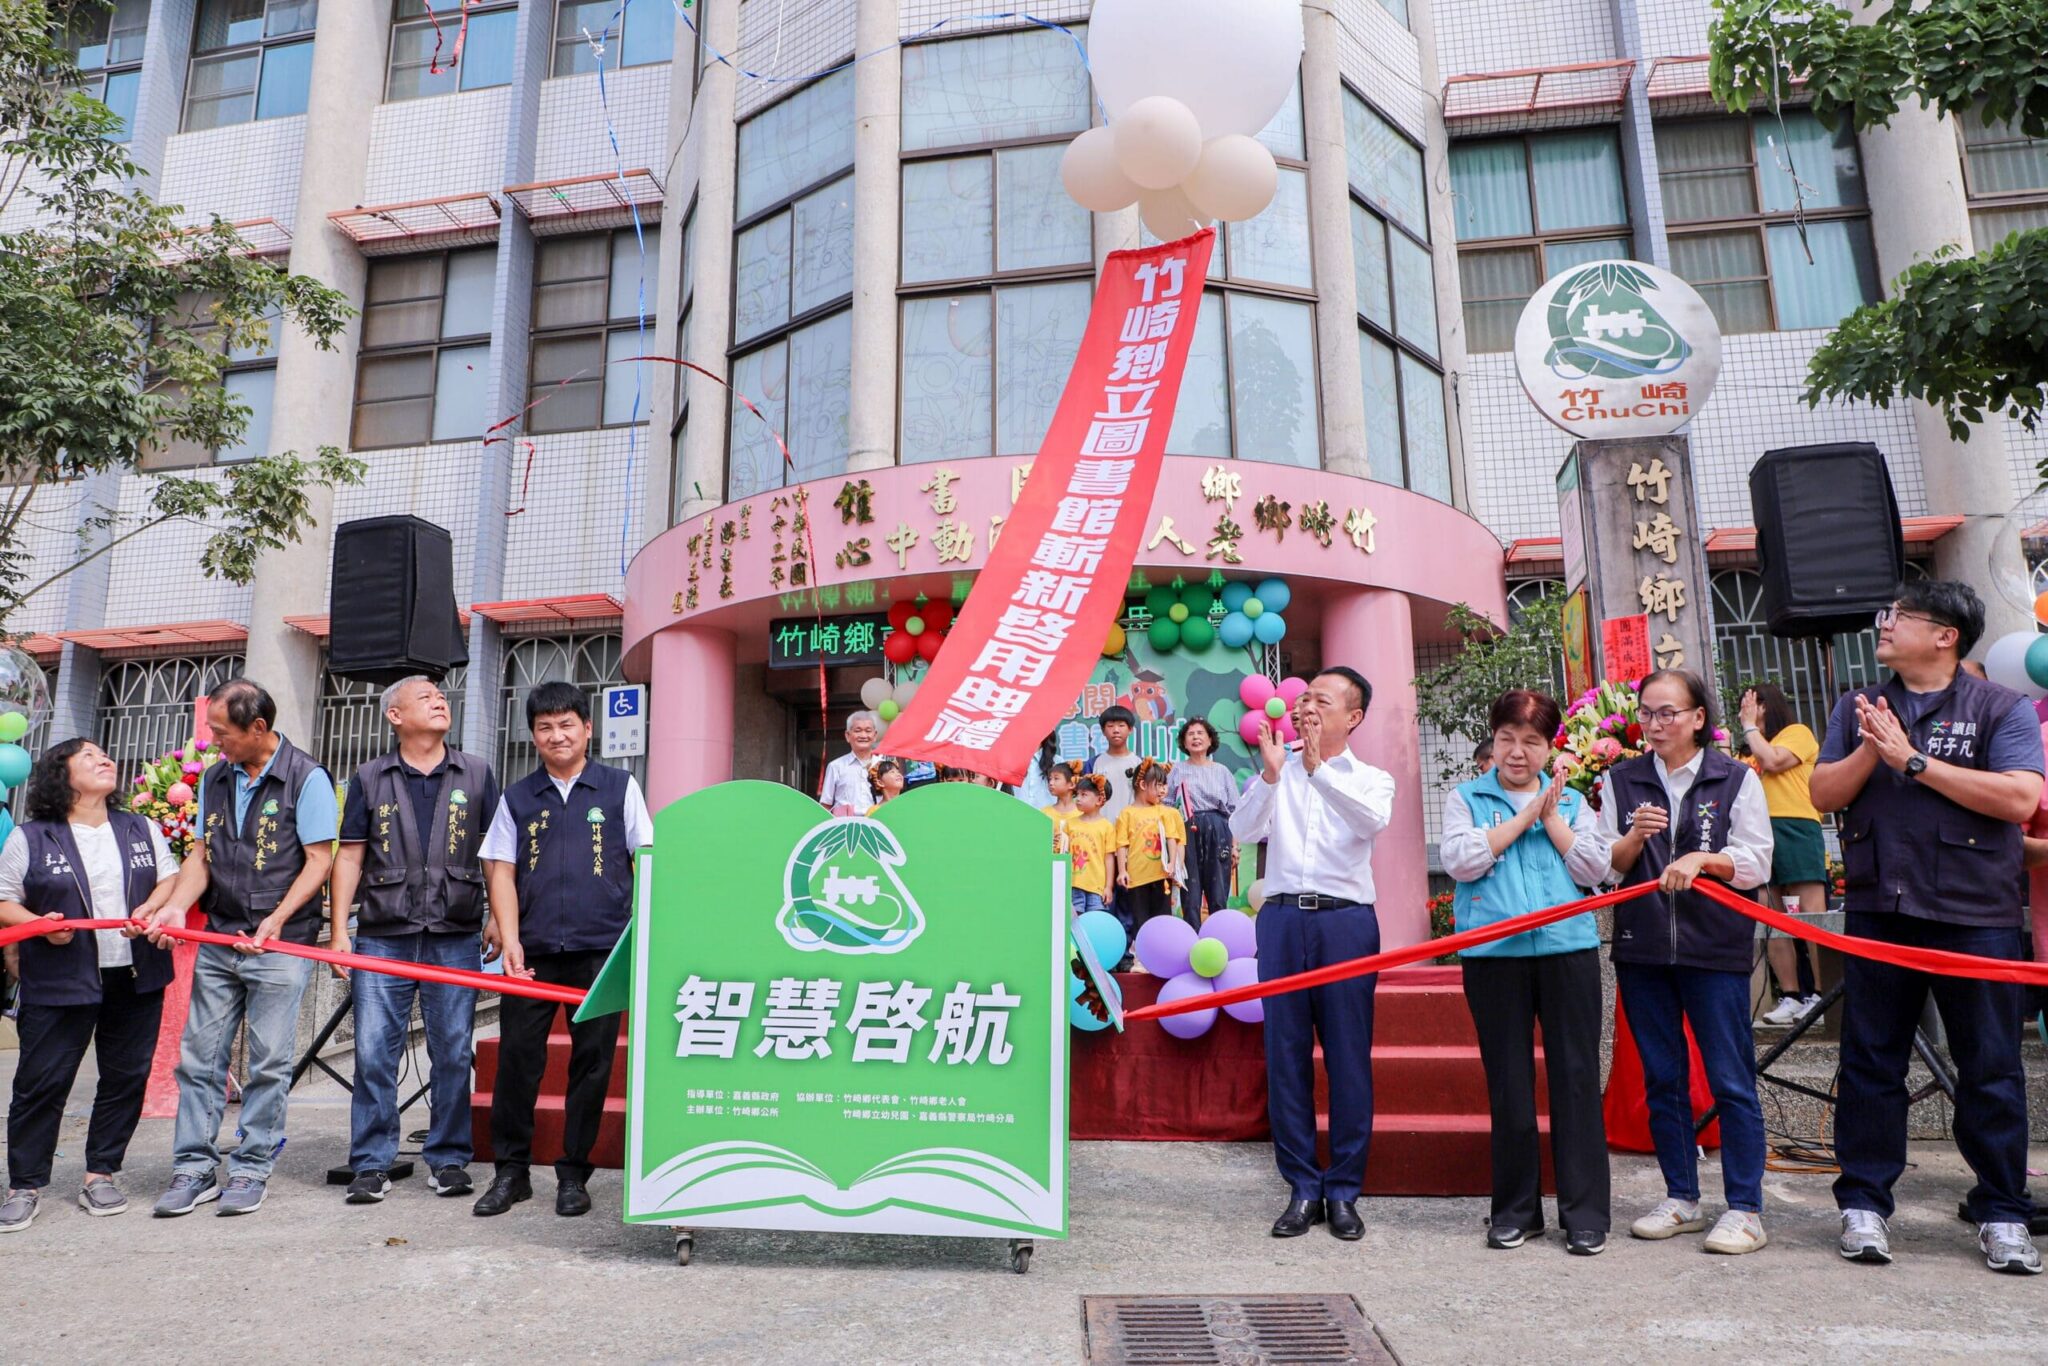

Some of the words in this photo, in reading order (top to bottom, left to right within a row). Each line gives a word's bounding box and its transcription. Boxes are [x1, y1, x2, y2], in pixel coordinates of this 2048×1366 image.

[1558, 381, 1688, 406] 竹崎
[1561, 401, 1689, 421] ChuChi
[1927, 736, 1974, 758] 何子凡
